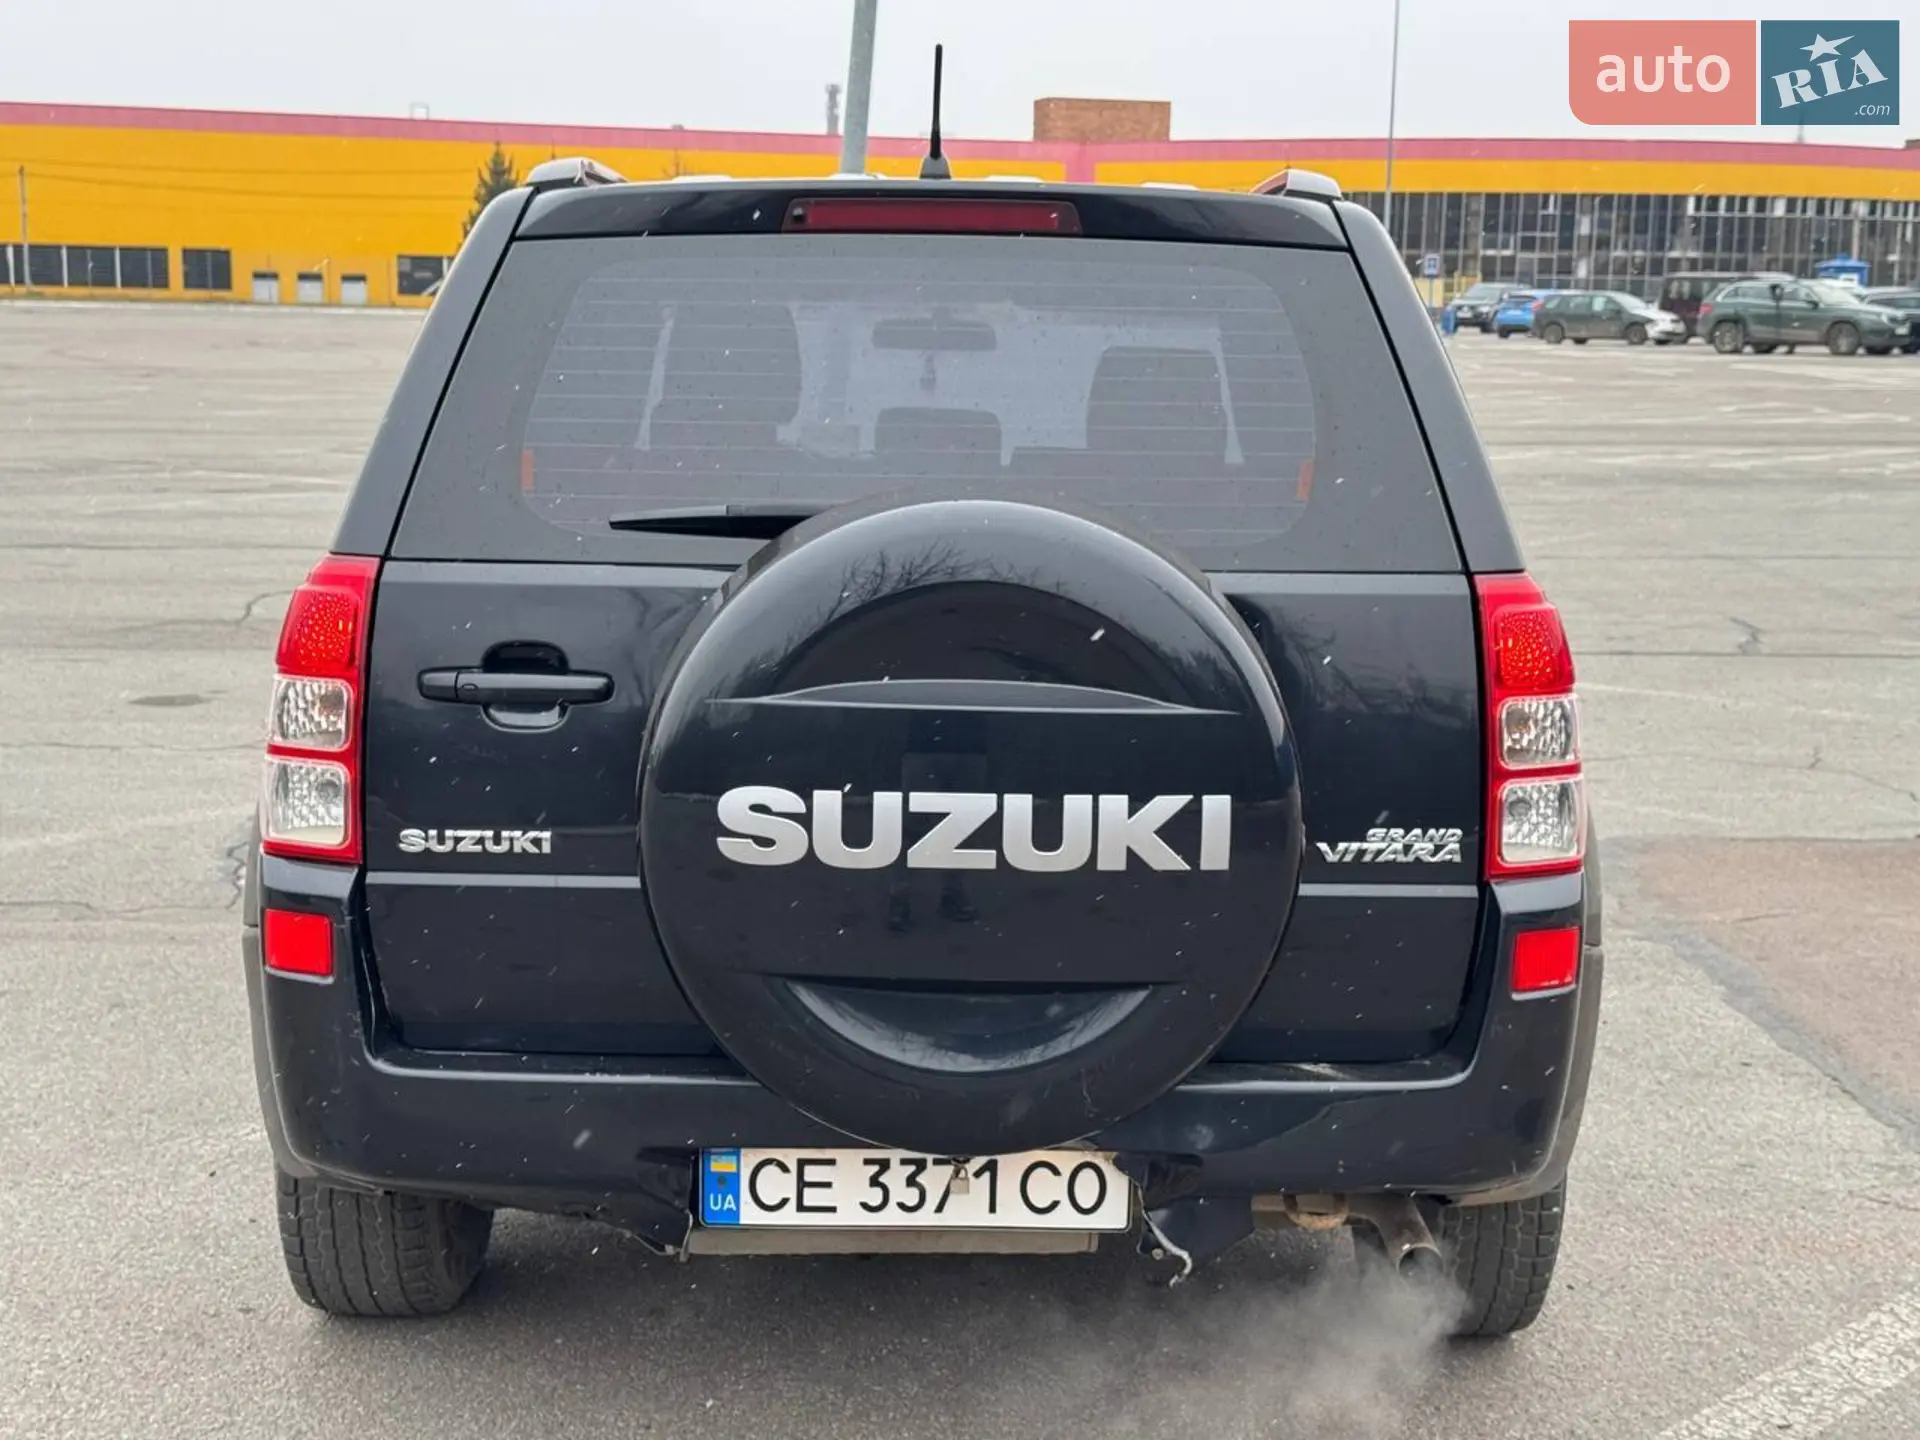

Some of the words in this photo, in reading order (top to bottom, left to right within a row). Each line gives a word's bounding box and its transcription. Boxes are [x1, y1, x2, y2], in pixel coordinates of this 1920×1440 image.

[398, 827, 552, 854] SUZUKI
[716, 785, 1232, 872] SUZUKI
[1366, 827, 1463, 844] GRAND
[1315, 842, 1462, 864] VITARA
[748, 1157, 838, 1214] CE
[858, 1157, 998, 1214] 3371
[1019, 1160, 1107, 1216] CO
[710, 1194, 737, 1212] UA
